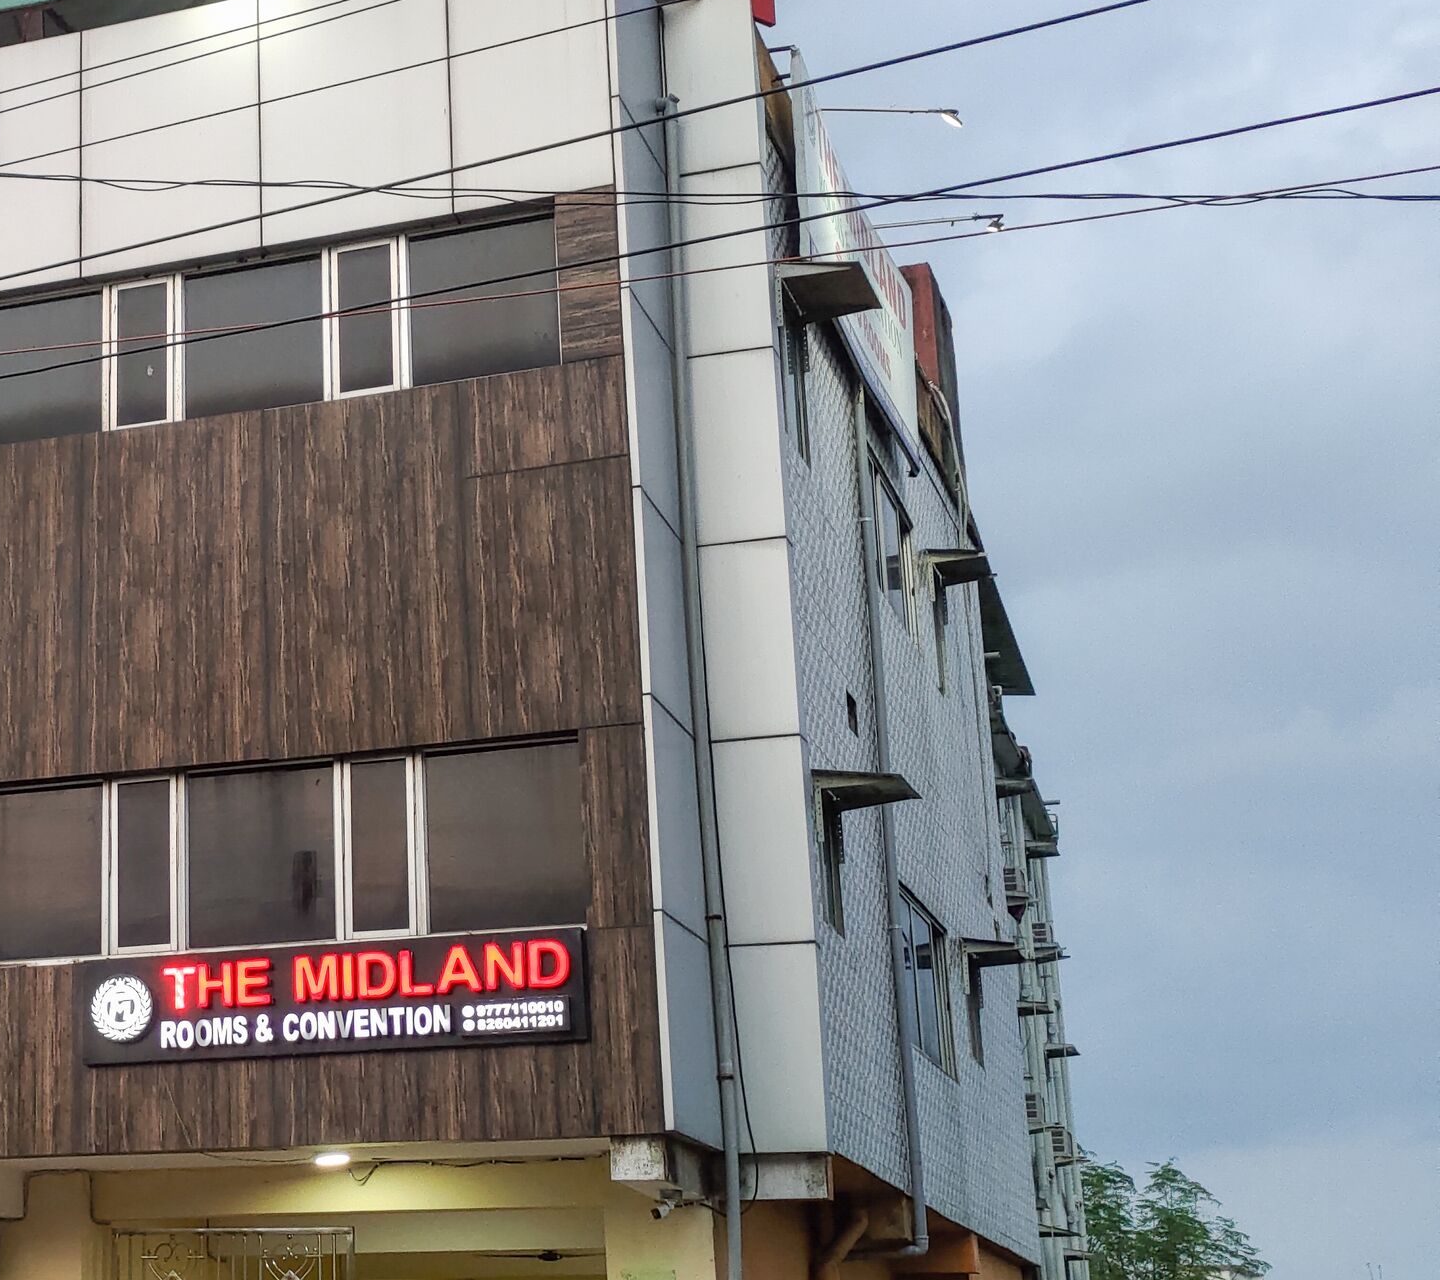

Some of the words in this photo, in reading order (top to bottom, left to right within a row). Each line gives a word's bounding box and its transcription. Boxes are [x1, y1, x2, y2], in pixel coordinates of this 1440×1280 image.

[162, 956, 273, 1010] THE
[292, 936, 572, 1005] MIDLAND
[476, 1000, 564, 1018] 9777110010
[477, 1014, 564, 1031] 8260411201
[160, 1017, 247, 1050] ROOMS
[254, 1014, 274, 1042] &
[283, 1004, 451, 1044] CONVENTION
